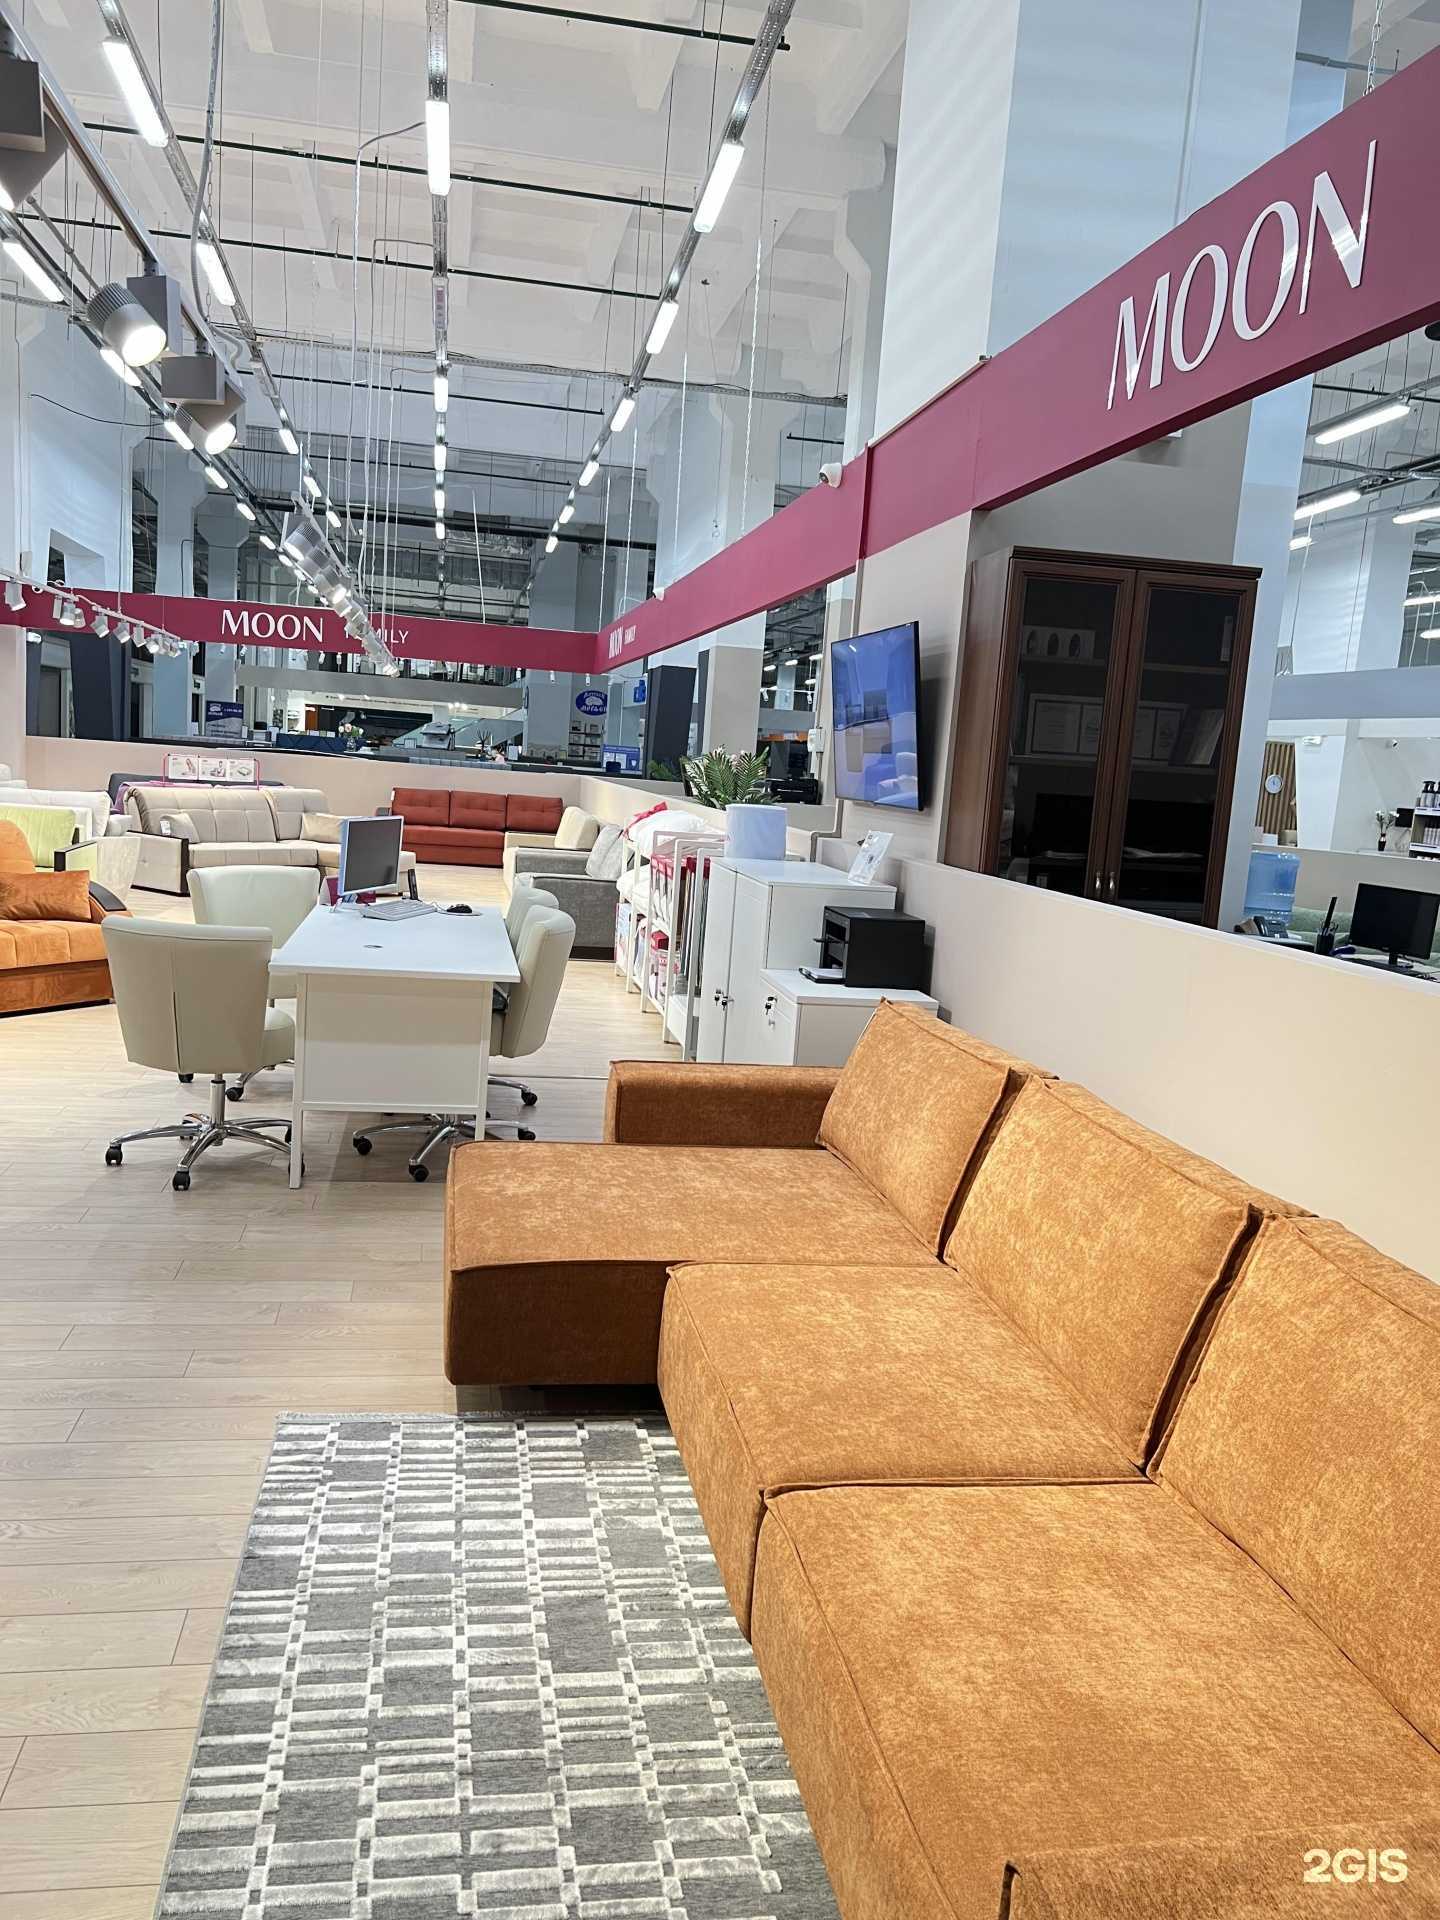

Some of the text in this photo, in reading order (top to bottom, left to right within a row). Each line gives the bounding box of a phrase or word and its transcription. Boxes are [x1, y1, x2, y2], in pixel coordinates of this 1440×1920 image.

[1106, 139, 1377, 411] MOON
[221, 609, 409, 644] MOON MILY
